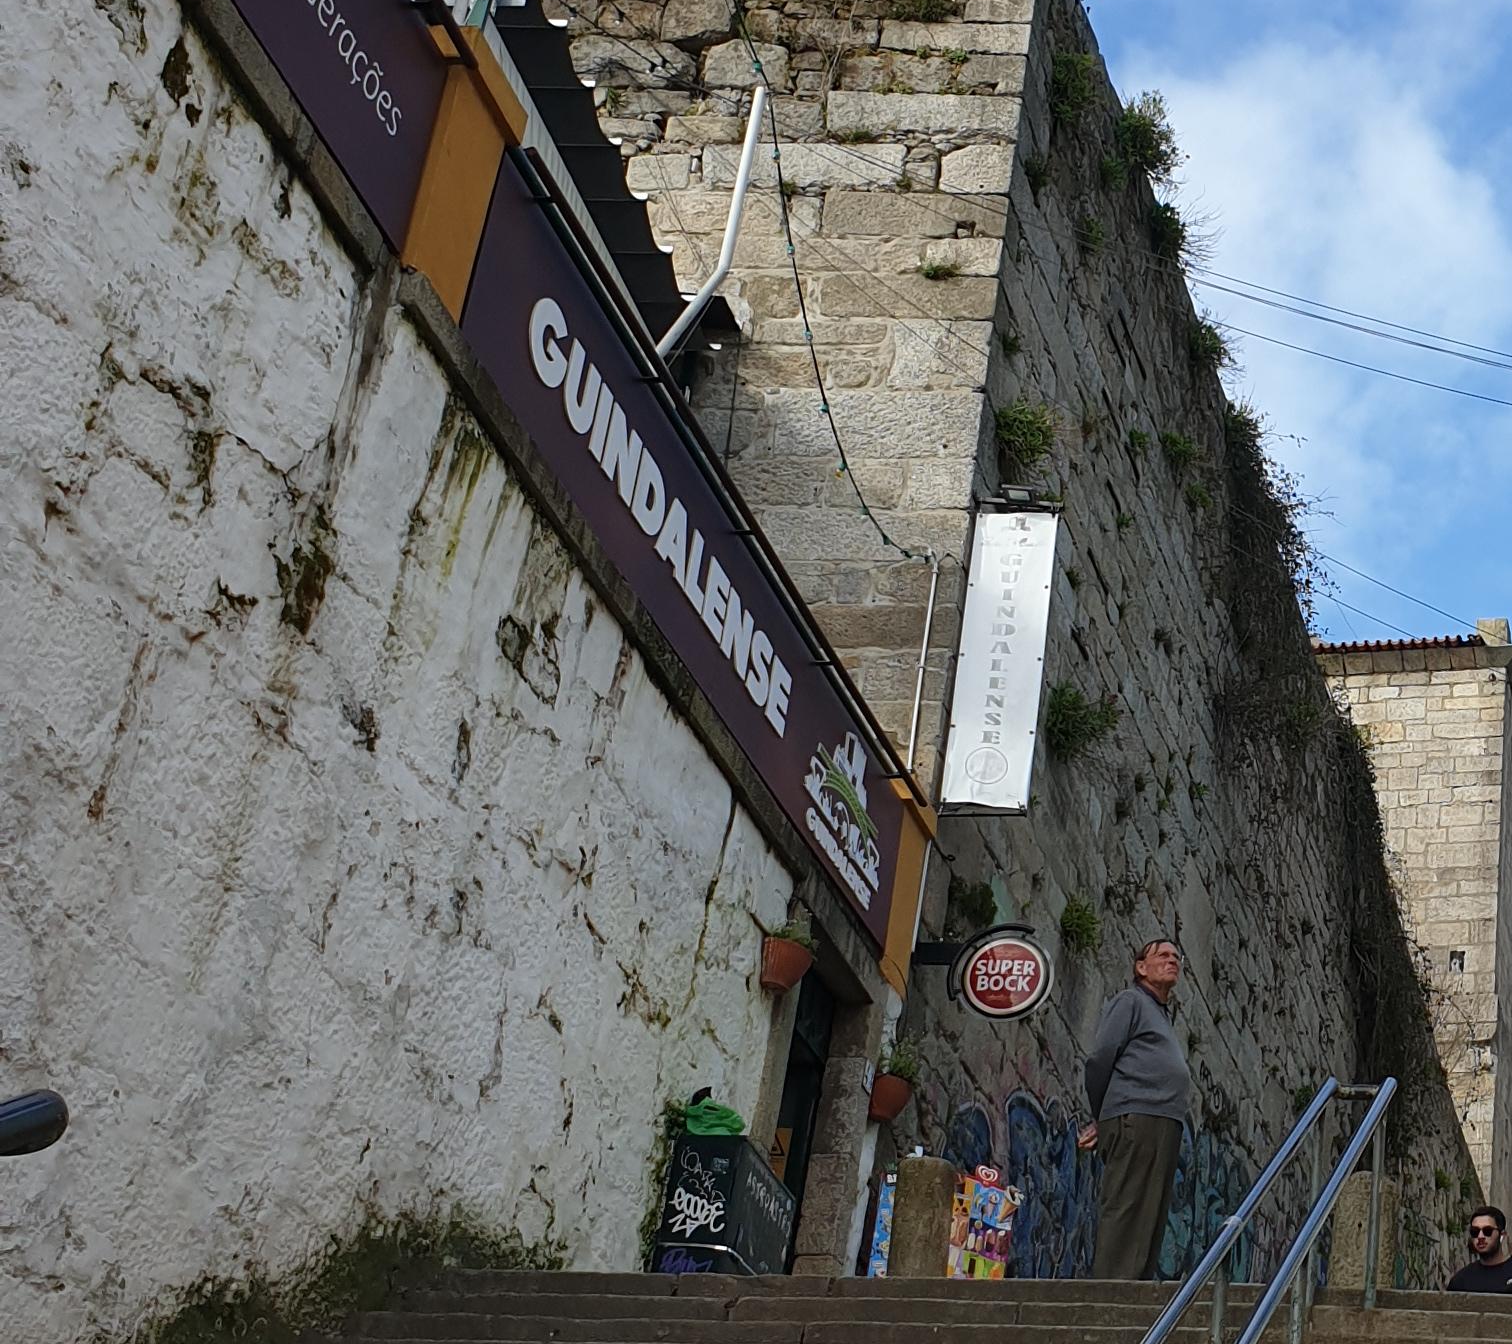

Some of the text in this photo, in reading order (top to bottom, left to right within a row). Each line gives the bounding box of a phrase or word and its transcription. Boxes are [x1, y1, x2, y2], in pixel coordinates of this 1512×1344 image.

[528, 297, 792, 739] GUINDALENSE
[979, 553, 1023, 745] GUINDALENSE
[975, 959, 1036, 976] SUPER
[976, 975, 1032, 992] BOCK
